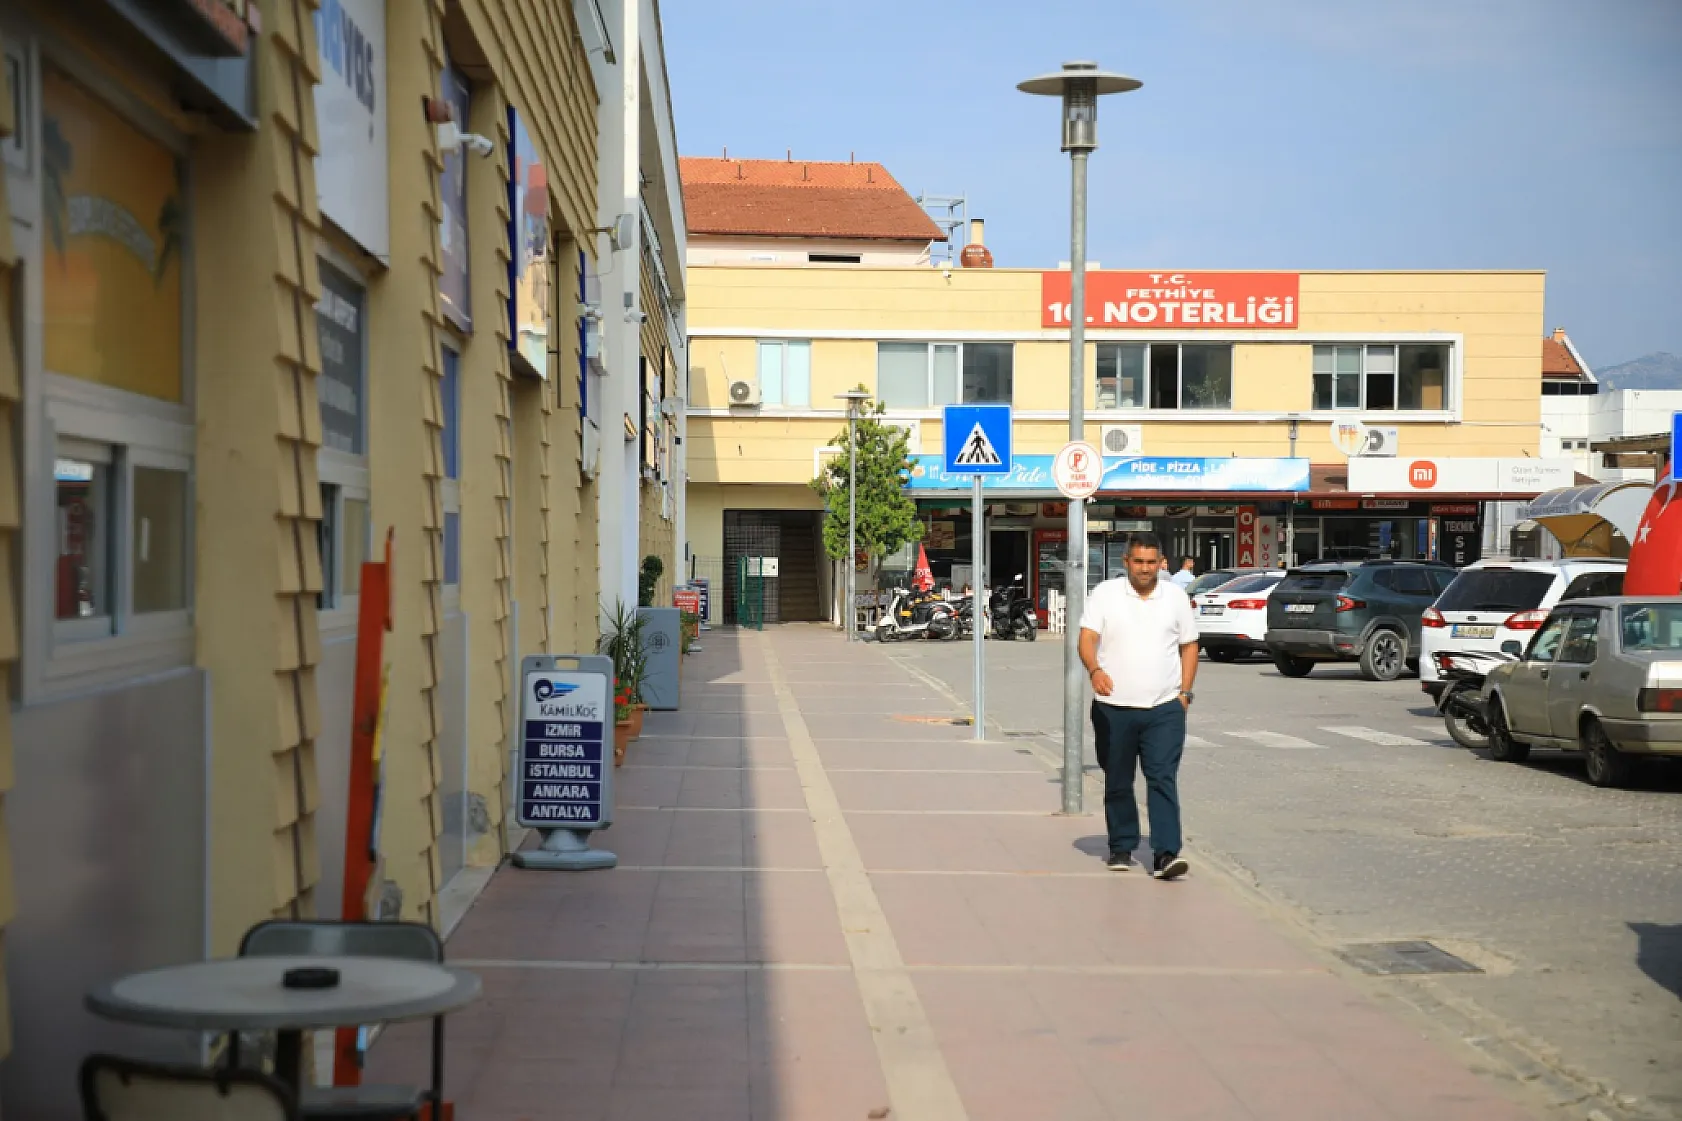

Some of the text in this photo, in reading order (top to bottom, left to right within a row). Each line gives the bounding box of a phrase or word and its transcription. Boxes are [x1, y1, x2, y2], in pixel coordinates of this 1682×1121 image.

[1149, 274, 1192, 284] T.C.
[1126, 286, 1215, 299] FETHİYE
[1104, 296, 1294, 323] NOTERLİĞİ
[1131, 461, 1157, 473] PİDE
[1167, 461, 1201, 473] PİZZA
[539, 744, 585, 758] BURSA
[533, 785, 590, 799] ANKARA
[531, 805, 591, 819] ANTALYA
